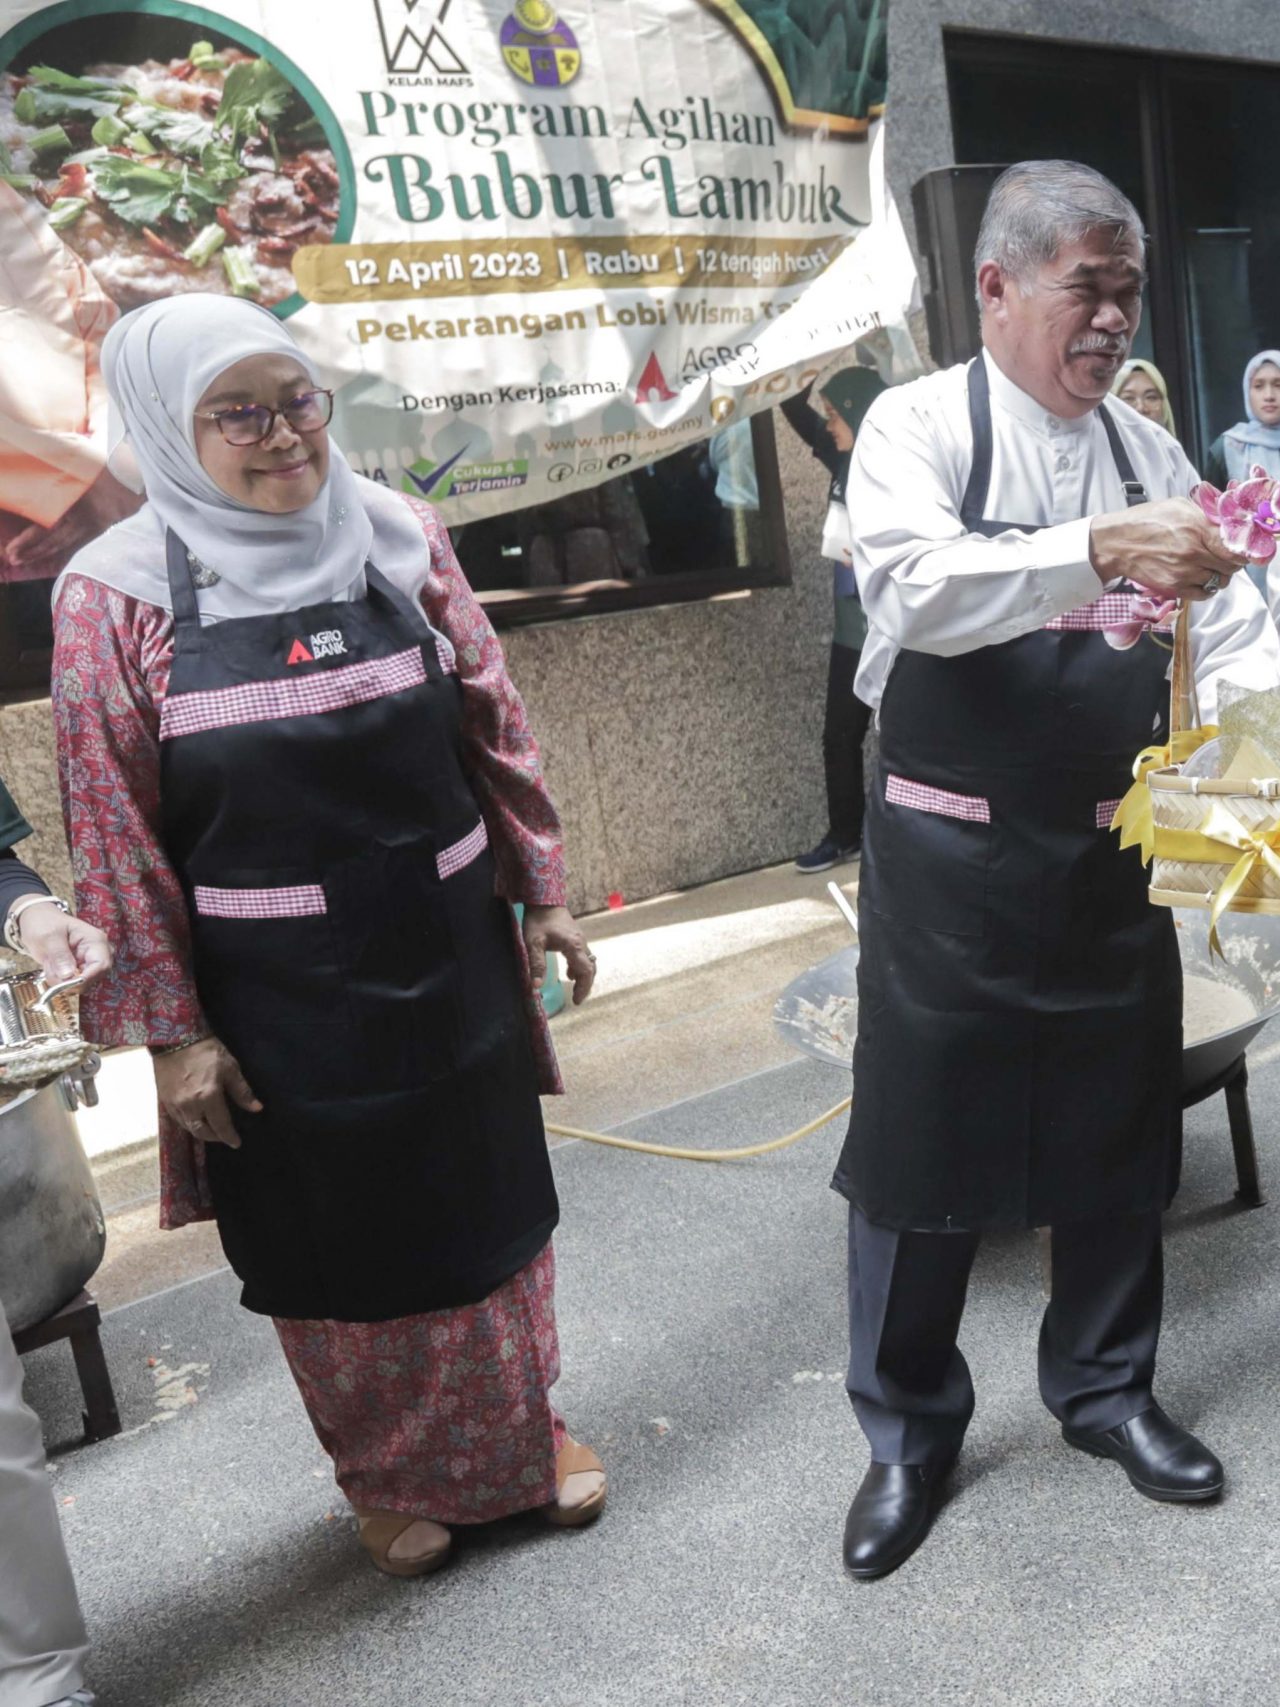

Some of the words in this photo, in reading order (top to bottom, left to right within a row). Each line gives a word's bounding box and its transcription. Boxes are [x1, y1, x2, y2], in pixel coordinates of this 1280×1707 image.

[357, 90, 610, 148] Program
[624, 96, 775, 151] Agihan
[363, 150, 624, 223] Bubur
[640, 155, 872, 227] Lambuk
[345, 258, 380, 286] 12
[387, 253, 464, 291] April
[468, 251, 542, 279] 2023
[585, 250, 660, 275] Rabu
[697, 249, 718, 273] 12
[720, 250, 783, 280] tengah
[784, 247, 830, 273] hari
[356, 309, 587, 345] Pekarangan
[595, 299, 668, 328] Lobi
[674, 299, 755, 326] Wisma
[402, 391, 493, 412] Dengan
[498, 379, 623, 404] Kerjasama:
[544, 415, 704, 453] www.mafs.gov.my
[452, 465, 502, 479] Cukup
[454, 475, 522, 494] Terjamin
[310, 629, 343, 647] AGRO
[312, 640, 349, 660] BANK
